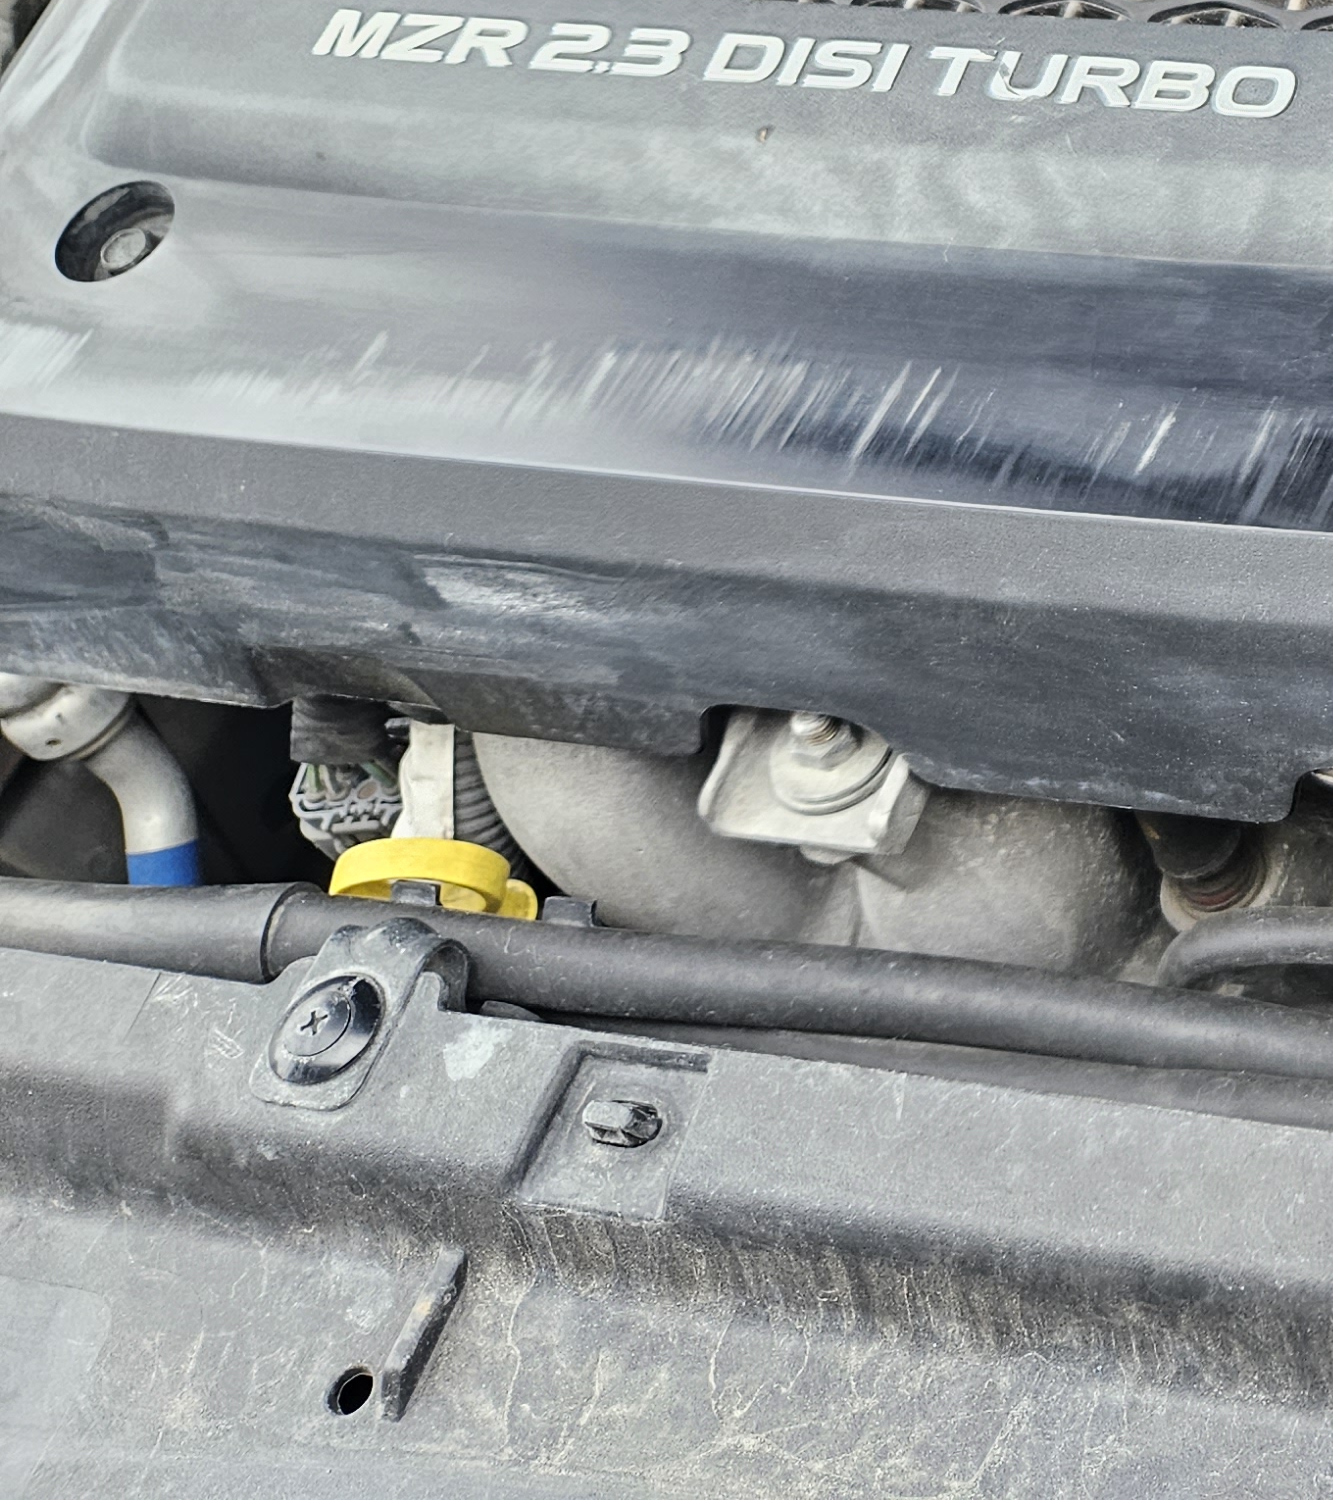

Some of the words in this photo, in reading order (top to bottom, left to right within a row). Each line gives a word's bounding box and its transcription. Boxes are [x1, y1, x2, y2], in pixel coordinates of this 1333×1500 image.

[312, 8, 529, 67] MZR
[528, 21, 692, 78] 2.3
[702, 32, 911, 93] DISI
[928, 45, 1297, 118] TURBO
